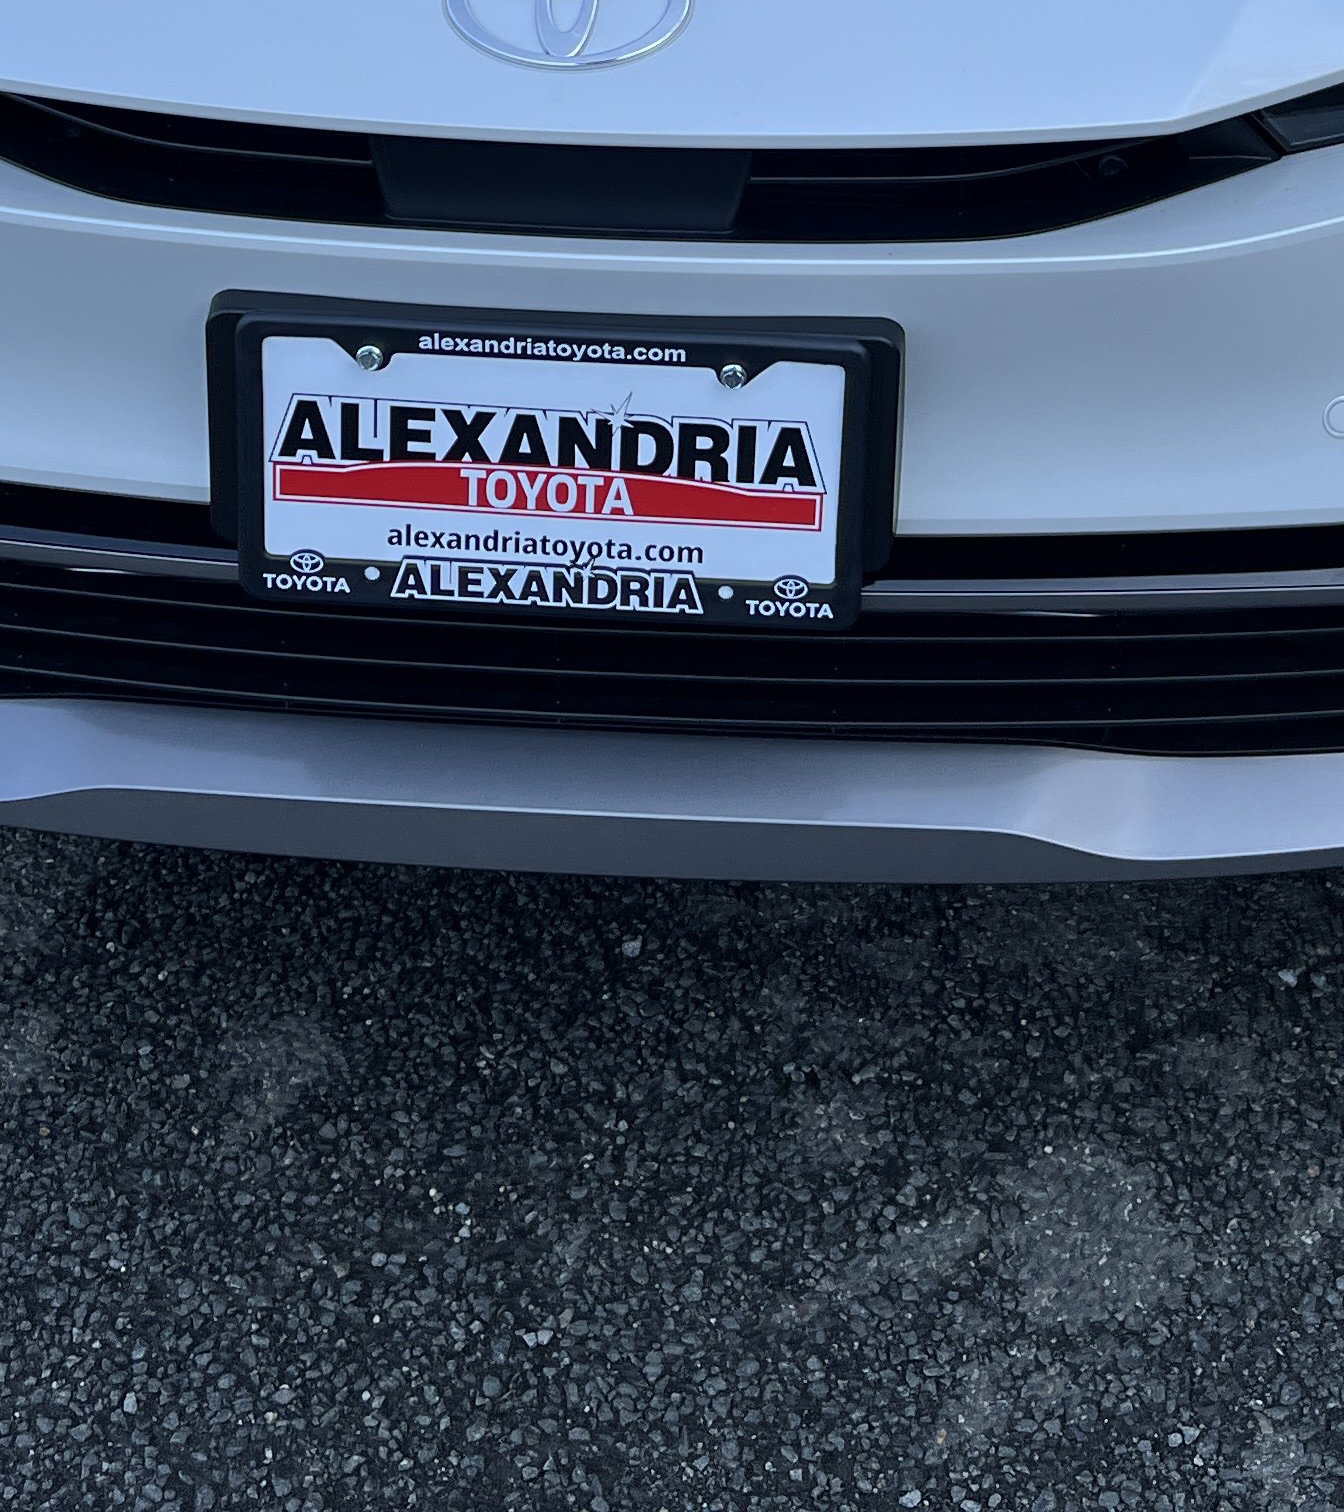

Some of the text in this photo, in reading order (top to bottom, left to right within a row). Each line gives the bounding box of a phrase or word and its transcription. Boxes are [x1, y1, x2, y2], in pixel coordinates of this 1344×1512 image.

[417, 331, 687, 364] alexandriatoyota.com
[273, 395, 823, 491] ALEXANDRIA
[459, 467, 635, 517] TOYOTA
[386, 523, 705, 566] alexandriatoyota.com
[262, 571, 351, 594] TOYOTA
[389, 557, 705, 615] ALEXANDRIA
[745, 598, 835, 621] TOYOTA
